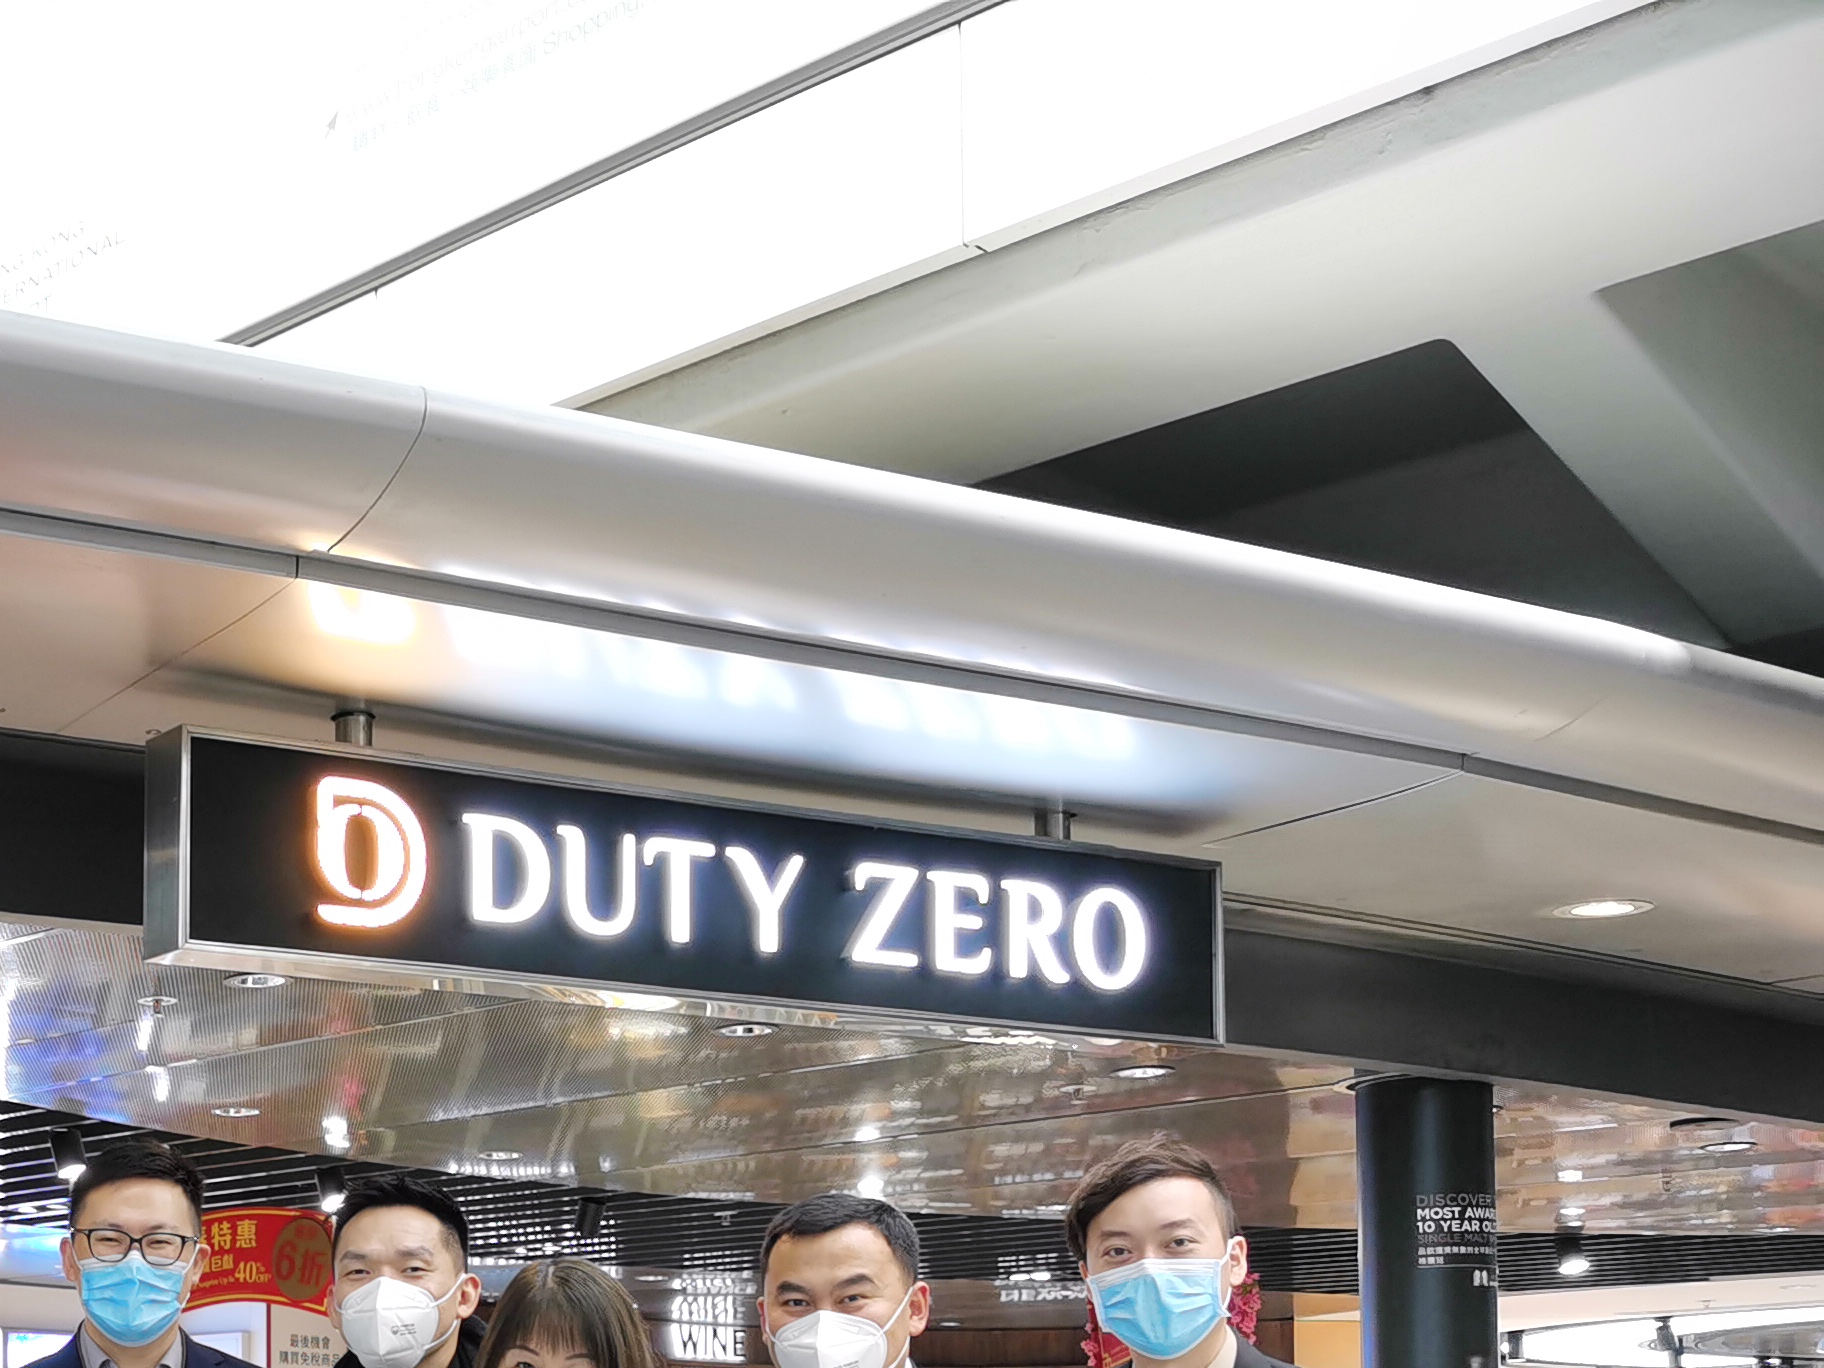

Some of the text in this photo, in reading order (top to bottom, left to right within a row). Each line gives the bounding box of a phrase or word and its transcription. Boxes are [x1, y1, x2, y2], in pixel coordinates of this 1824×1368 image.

[461, 812, 805, 954] DUTY
[849, 861, 1148, 992] ZERO
[1416, 1193, 1492, 1208] DISCOVER
[1416, 1207, 1462, 1220] MOST
[1416, 1220, 1435, 1233] 10
[1439, 1220, 1480, 1233] YEAR
[670, 1322, 747, 1362] WINE
